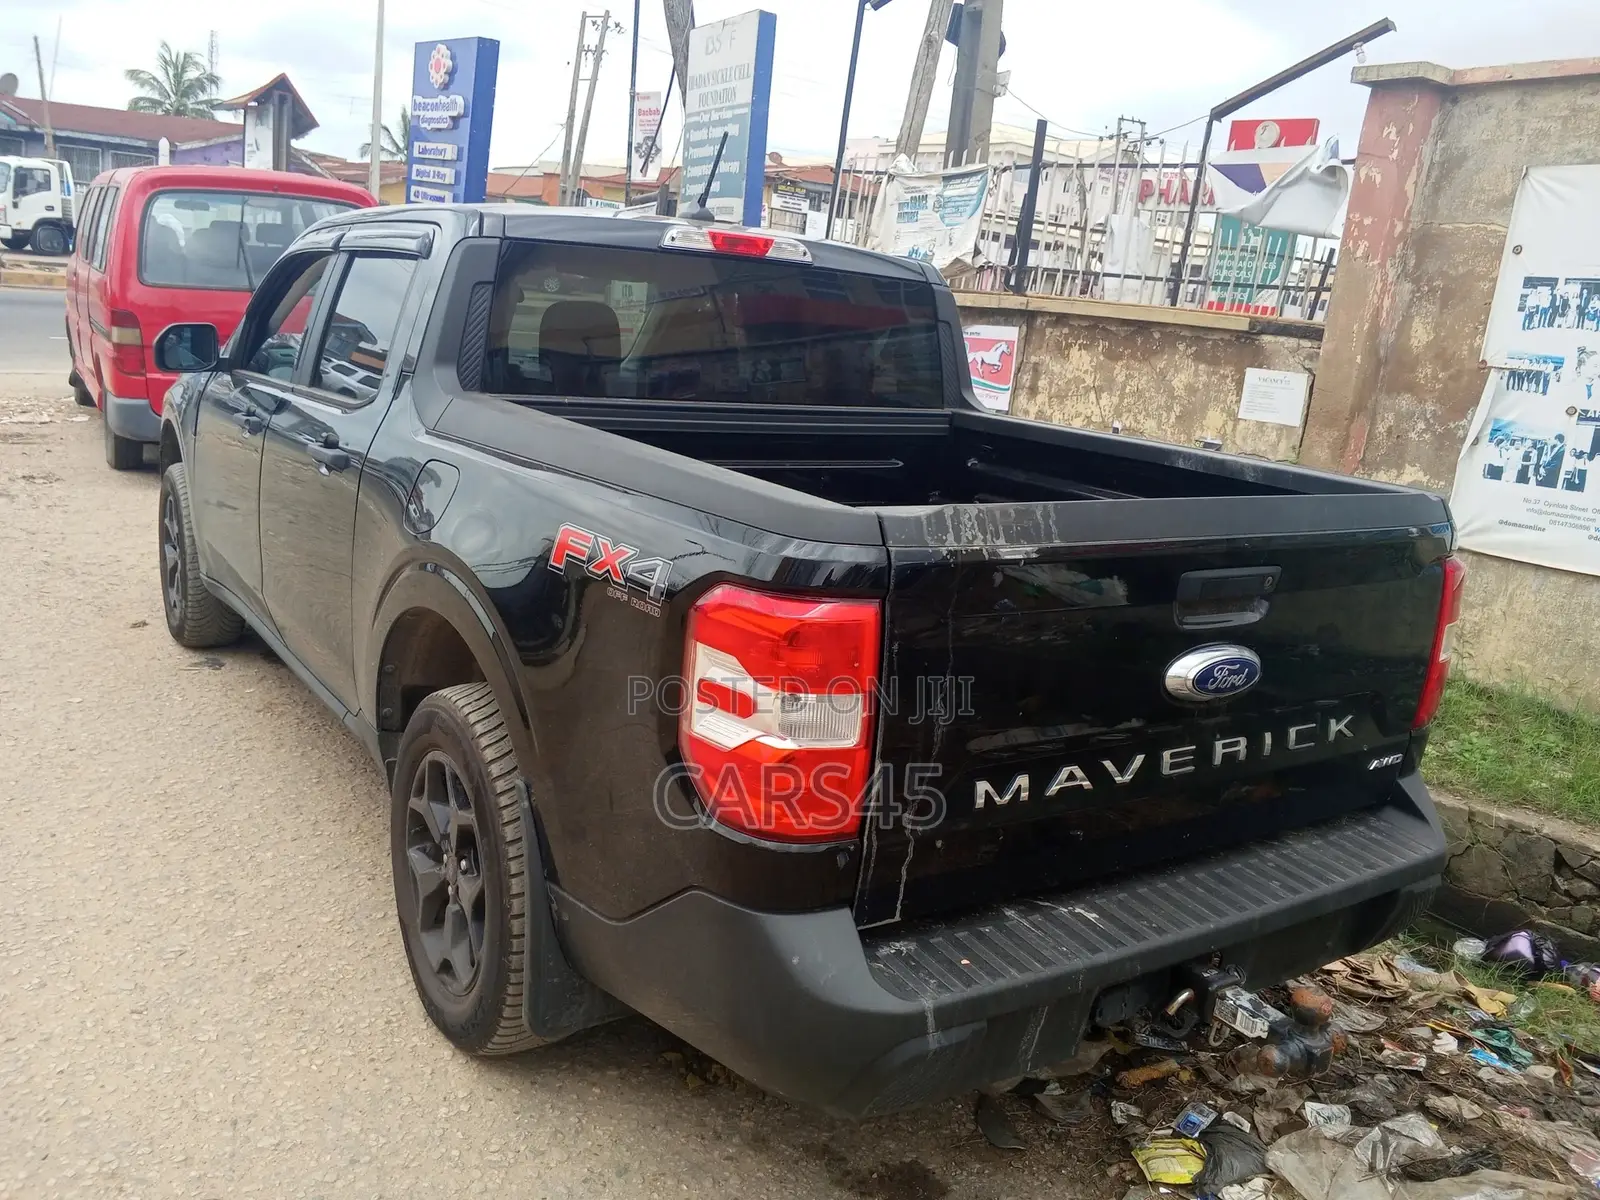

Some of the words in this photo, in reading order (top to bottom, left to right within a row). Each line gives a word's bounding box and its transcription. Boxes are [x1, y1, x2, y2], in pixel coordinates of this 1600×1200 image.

[698, 86, 738, 108] FOUNDATION
[417, 144, 448, 158] Laboratory
[415, 168, 431, 180] Digital
[1569, 504, 1589, 513] Street
[1498, 519, 1547, 532] @domaconline
[548, 522, 674, 606] FX4
[607, 587, 629, 602] OFF
[630, 596, 662, 618] ROAD
[1208, 664, 1249, 690] Ford
[974, 714, 1355, 810] MAVERICK
[1367, 753, 1403, 770] AWD
